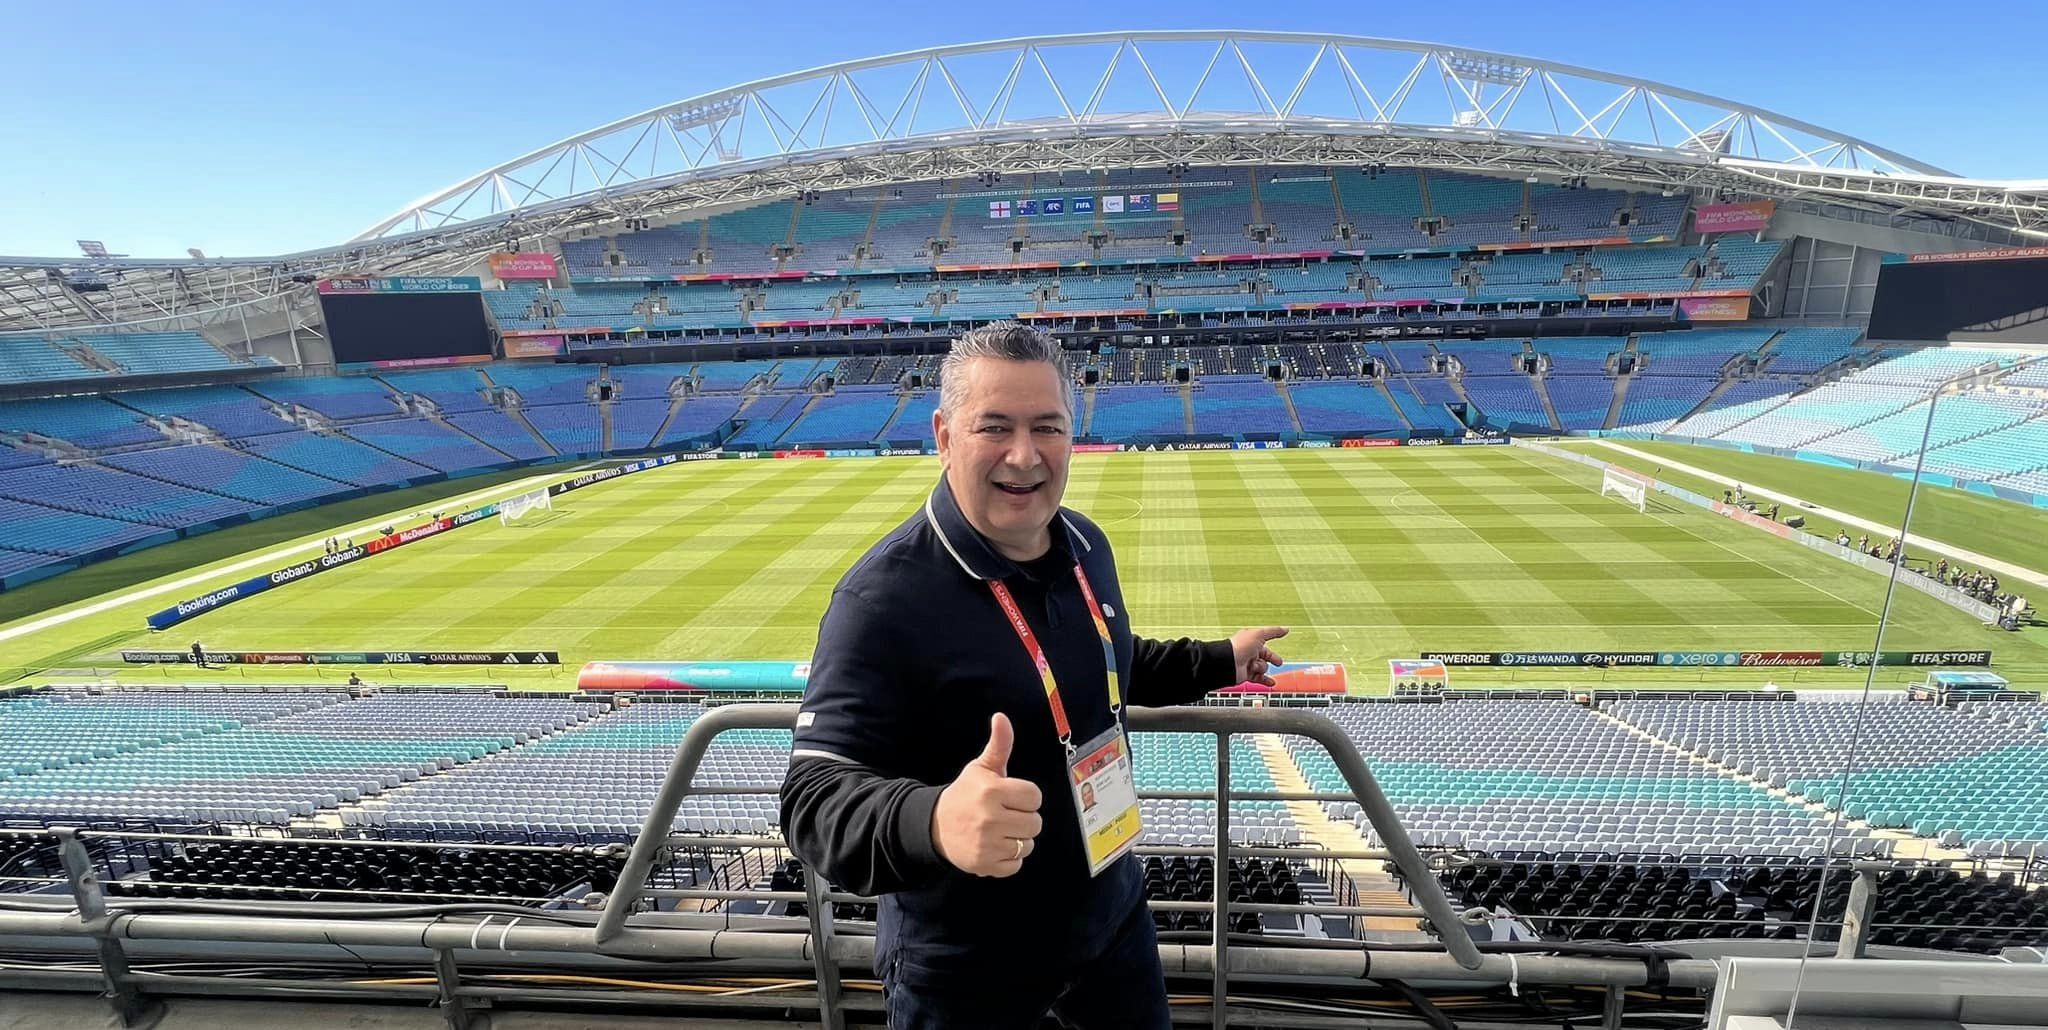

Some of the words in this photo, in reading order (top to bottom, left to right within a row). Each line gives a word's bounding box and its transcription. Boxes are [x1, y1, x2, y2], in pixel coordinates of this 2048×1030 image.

[1075, 202, 1091, 210] FIFA
[1912, 254, 1930, 262] FIFA
[1968, 251, 1997, 259] WORLD
[1999, 249, 2016, 258] CUP
[1264, 441, 1284, 449] VISA
[1407, 438, 1439, 447] Globant
[1461, 437, 1505, 446] Booking.com
[643, 458, 659, 469] VISA
[661, 453, 677, 464] VISA
[624, 463, 641, 473] VISA
[400, 521, 446, 542] McDonald's
[321, 546, 361, 568] Globant
[271, 562, 313, 584] Globant
[177, 586, 239, 616] Booking.com
[125, 652, 181, 665] Booking.com
[187, 653, 231, 664] Gbant
[385, 652, 412, 662] VISA
[430, 653, 455, 662] QATAR
[457, 653, 492, 662] AIRWAYS
[1603, 655, 1654, 664] HYUNDAI
[1679, 653, 1718, 665] xero
[1740, 653, 1821, 667] Budweiser
